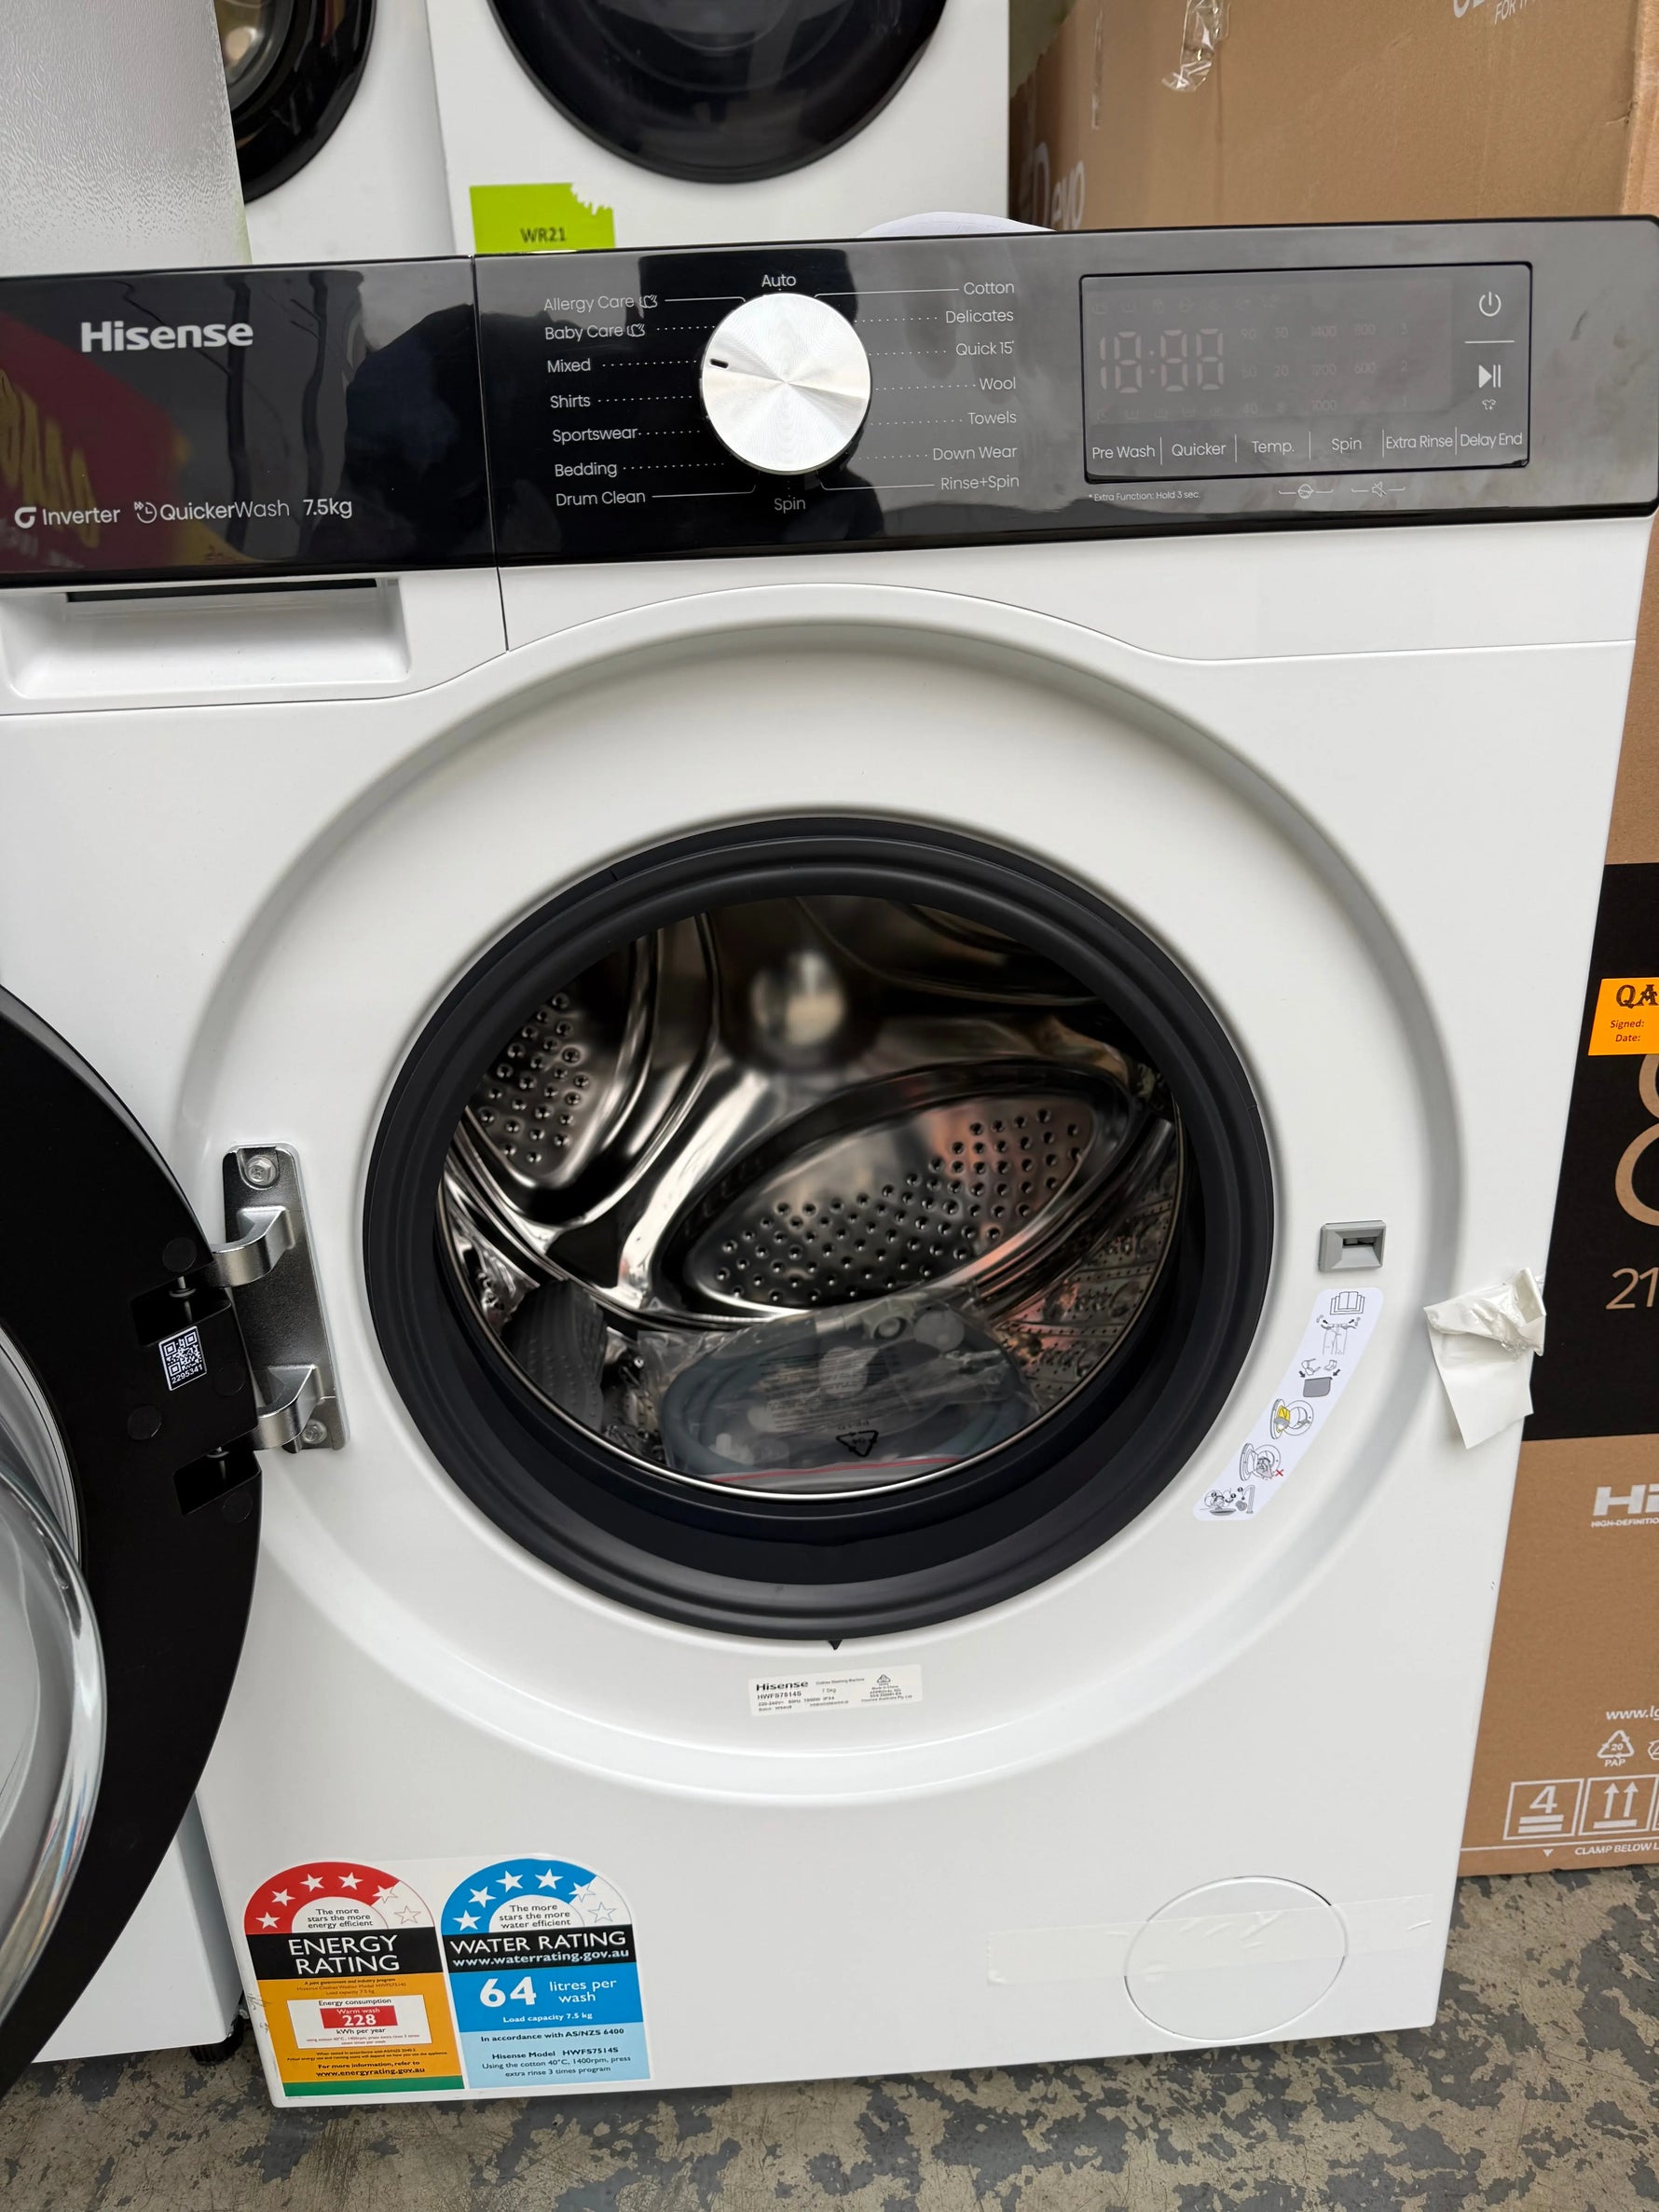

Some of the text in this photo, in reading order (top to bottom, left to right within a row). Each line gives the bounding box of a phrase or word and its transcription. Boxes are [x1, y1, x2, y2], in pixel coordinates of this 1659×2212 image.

[520, 227, 566, 242] WR21
[761, 274, 797, 287] Auto
[964, 282, 1015, 295] Cotton
[544, 295, 635, 313] Allergy Care
[946, 309, 1014, 323] Delicates
[81, 321, 254, 353] Hisense
[545, 324, 624, 342] Baby Care
[955, 342, 996, 357] Quick
[547, 358, 591, 373] Mixed
[980, 377, 1017, 391] Wool
[550, 394, 591, 408] Shirts
[967, 410, 1017, 425] Towels
[553, 427, 638, 445] Sportswear
[1386, 434, 1454, 449] Extra Rinse
[1460, 433, 1523, 449] Delay End
[1092, 445, 1156, 460] Pre Wash
[1172, 443, 1227, 457] Quicker
[1252, 440, 1295, 454] Temp.
[1331, 436, 1363, 454] Spin
[933, 446, 1018, 460] Down Wear
[555, 462, 618, 477] Bedding
[940, 474, 1020, 491] Rinse+Spin
[555, 490, 646, 506] Drum Clean
[1094, 493, 1115, 501] Extra
[1156, 490, 1175, 500] Hold
[1177, 490, 1183, 499] 3
[42, 498, 352, 526] Inverter QuickerWash 7.5kg
[774, 497, 806, 513] Spin
[1610, 1019, 1645, 1030] Signed:
[1615, 1034, 1641, 1042] Date:
[171, 1364, 202, 1384] 2295341
[756, 1681, 809, 1691] Hisense
[1604, 1758, 1626, 1767] PAP
[1529, 1785, 1557, 1814] 4
[1575, 1845, 1612, 1855] CLAMP
[1613, 1842, 1652, 1853] BELOW
[532, 1919, 571, 1928] efficient
[288, 1934, 398, 1956] ENERGY
[449, 1930, 626, 1955] WATER RATING
[295, 1955, 400, 1975] RATING
[452, 1949, 629, 1967] www.waterrating.gov.au
[479, 1976, 616, 2008] 64 litres per
[558, 1992, 596, 2003] wash
[342, 2014, 377, 2027] 228
[528, 2013, 564, 2023] capacity
[582, 2012, 593, 2021] kg
[565, 2029, 601, 2038] AS/NZS
[316, 2068, 425, 2077] www.energyrating.gov.au
[482, 2062, 504, 2070] Using
[578, 2066, 611, 2075] program
